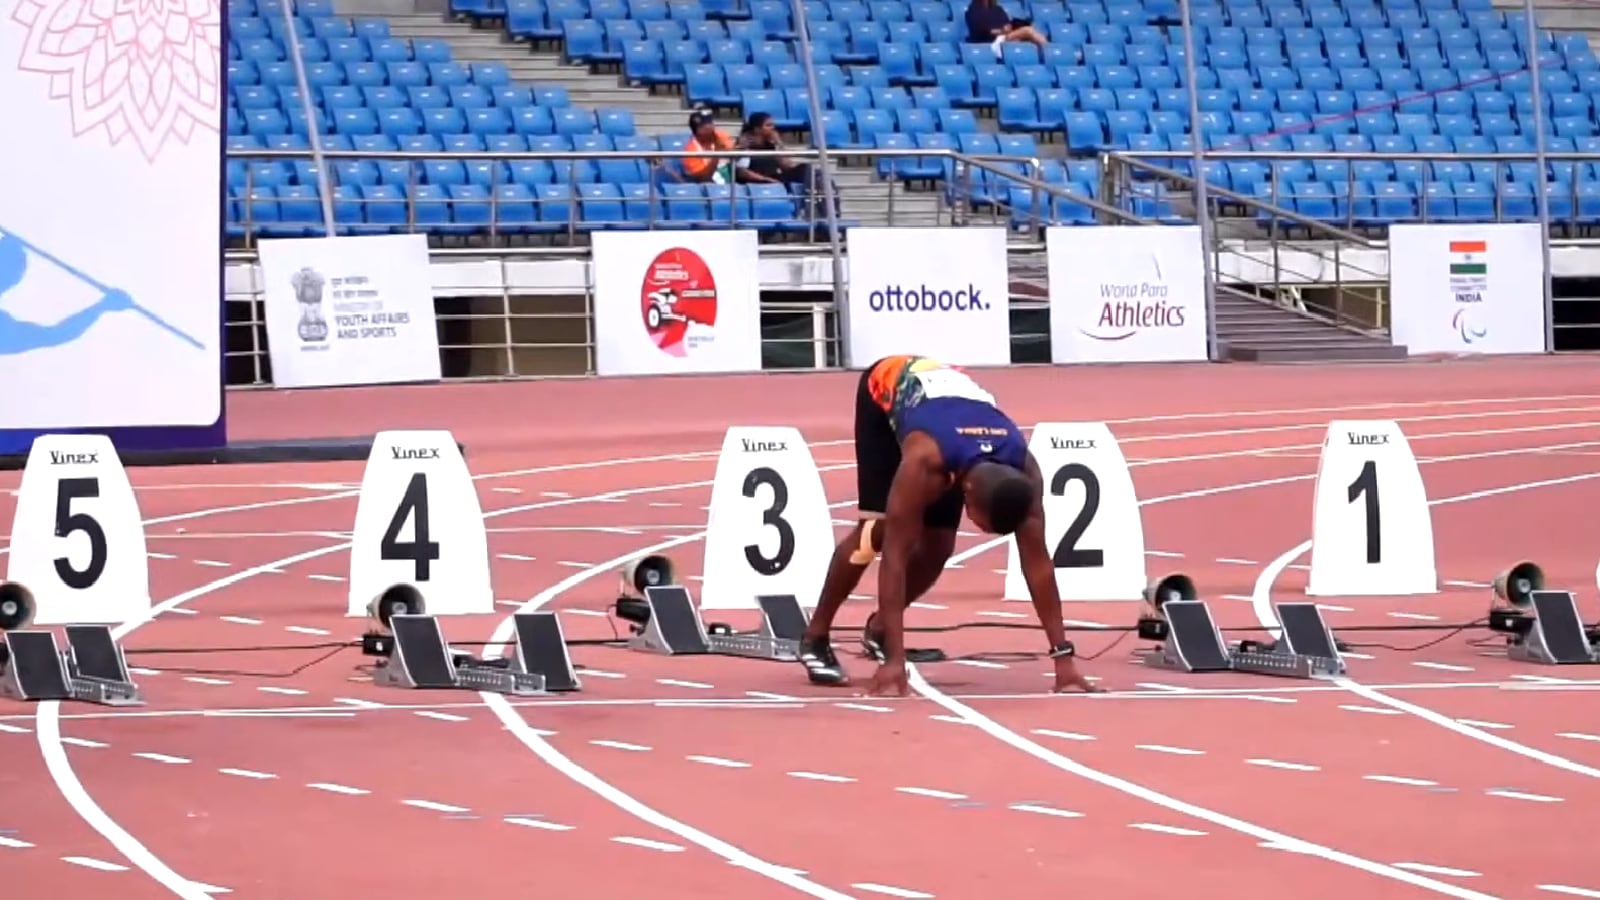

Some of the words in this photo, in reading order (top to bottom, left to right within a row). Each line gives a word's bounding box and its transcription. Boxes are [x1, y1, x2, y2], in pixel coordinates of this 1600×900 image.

[868, 283, 991, 312] ottobock.
[1100, 284, 1138, 298] World
[1140, 282, 1168, 297] Para
[1454, 292, 1483, 303] INDIA
[335, 314, 369, 327] YOUTH
[371, 312, 410, 325] AFFAIRS
[1098, 299, 1186, 328] Athletics
[337, 328, 359, 339] AND
[360, 326, 397, 339] SPORTS
[741, 438, 788, 453] Vinex
[1050, 437, 1097, 449] Vinex
[1347, 432, 1389, 445] Vinex
[50, 450, 98, 465] Vinex
[391, 446, 440, 460] Vinex
[1050, 462, 1104, 568] 2
[1347, 460, 1381, 564] 1
[381, 472, 440, 582] 4
[742, 466, 795, 576] 3
[53, 477, 107, 590] 5
